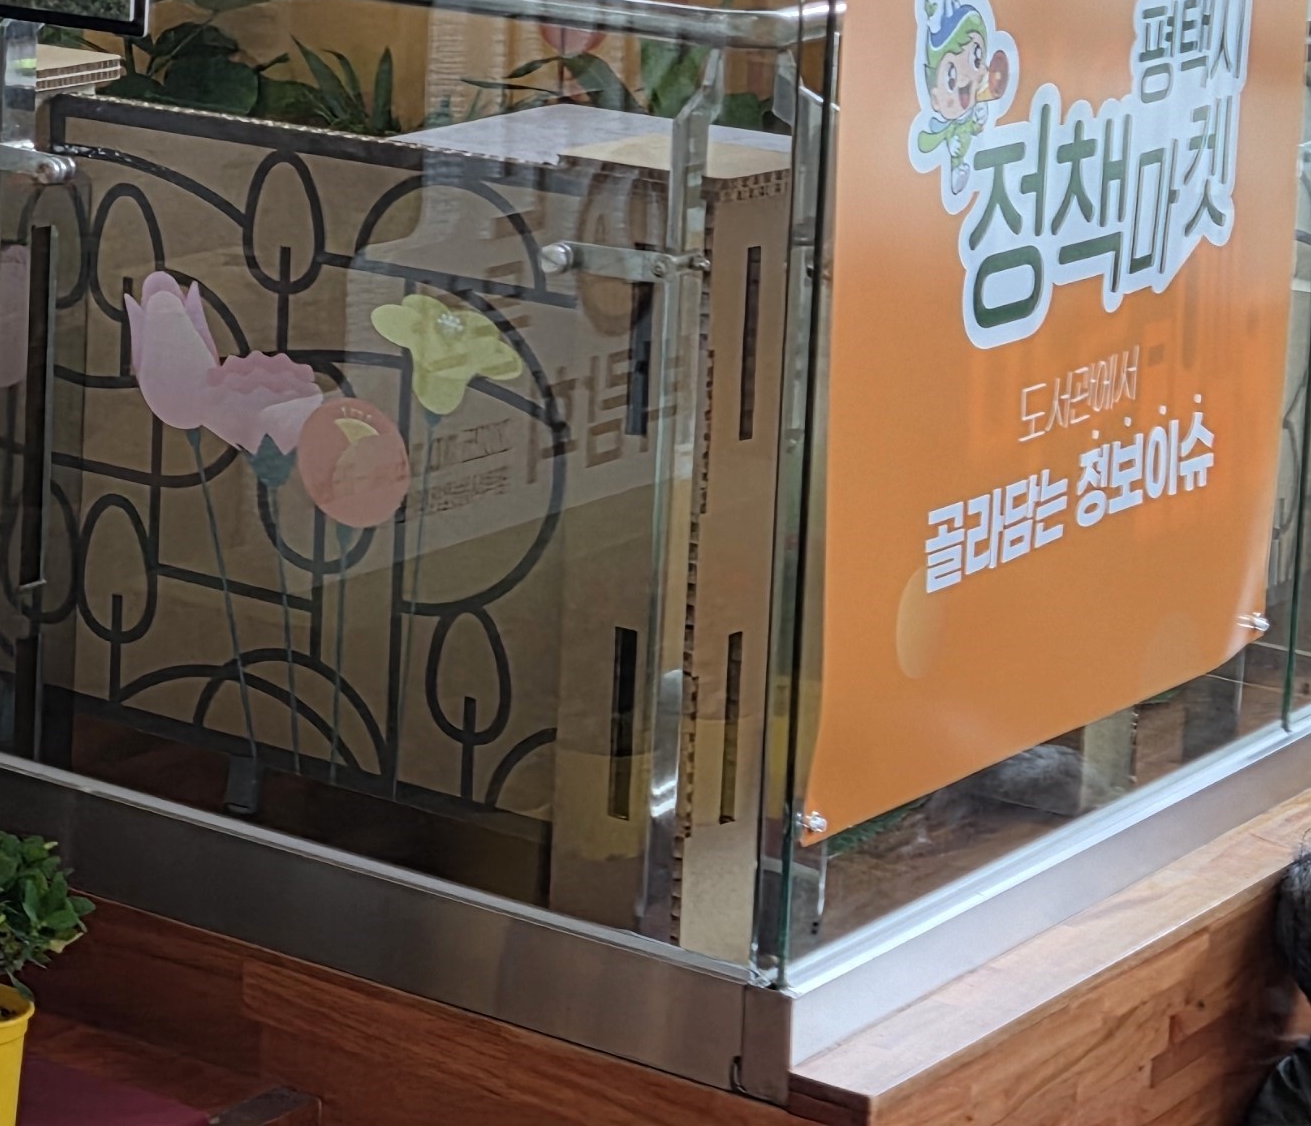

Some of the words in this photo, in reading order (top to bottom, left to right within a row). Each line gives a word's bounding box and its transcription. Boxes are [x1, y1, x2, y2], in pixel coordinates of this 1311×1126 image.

[970, 96, 1232, 330] 정책마켓
[1018, 344, 1140, 443] 도서관에서
[925, 469, 1068, 594] 골라담는
[1076, 399, 1216, 528] 정보이슈
